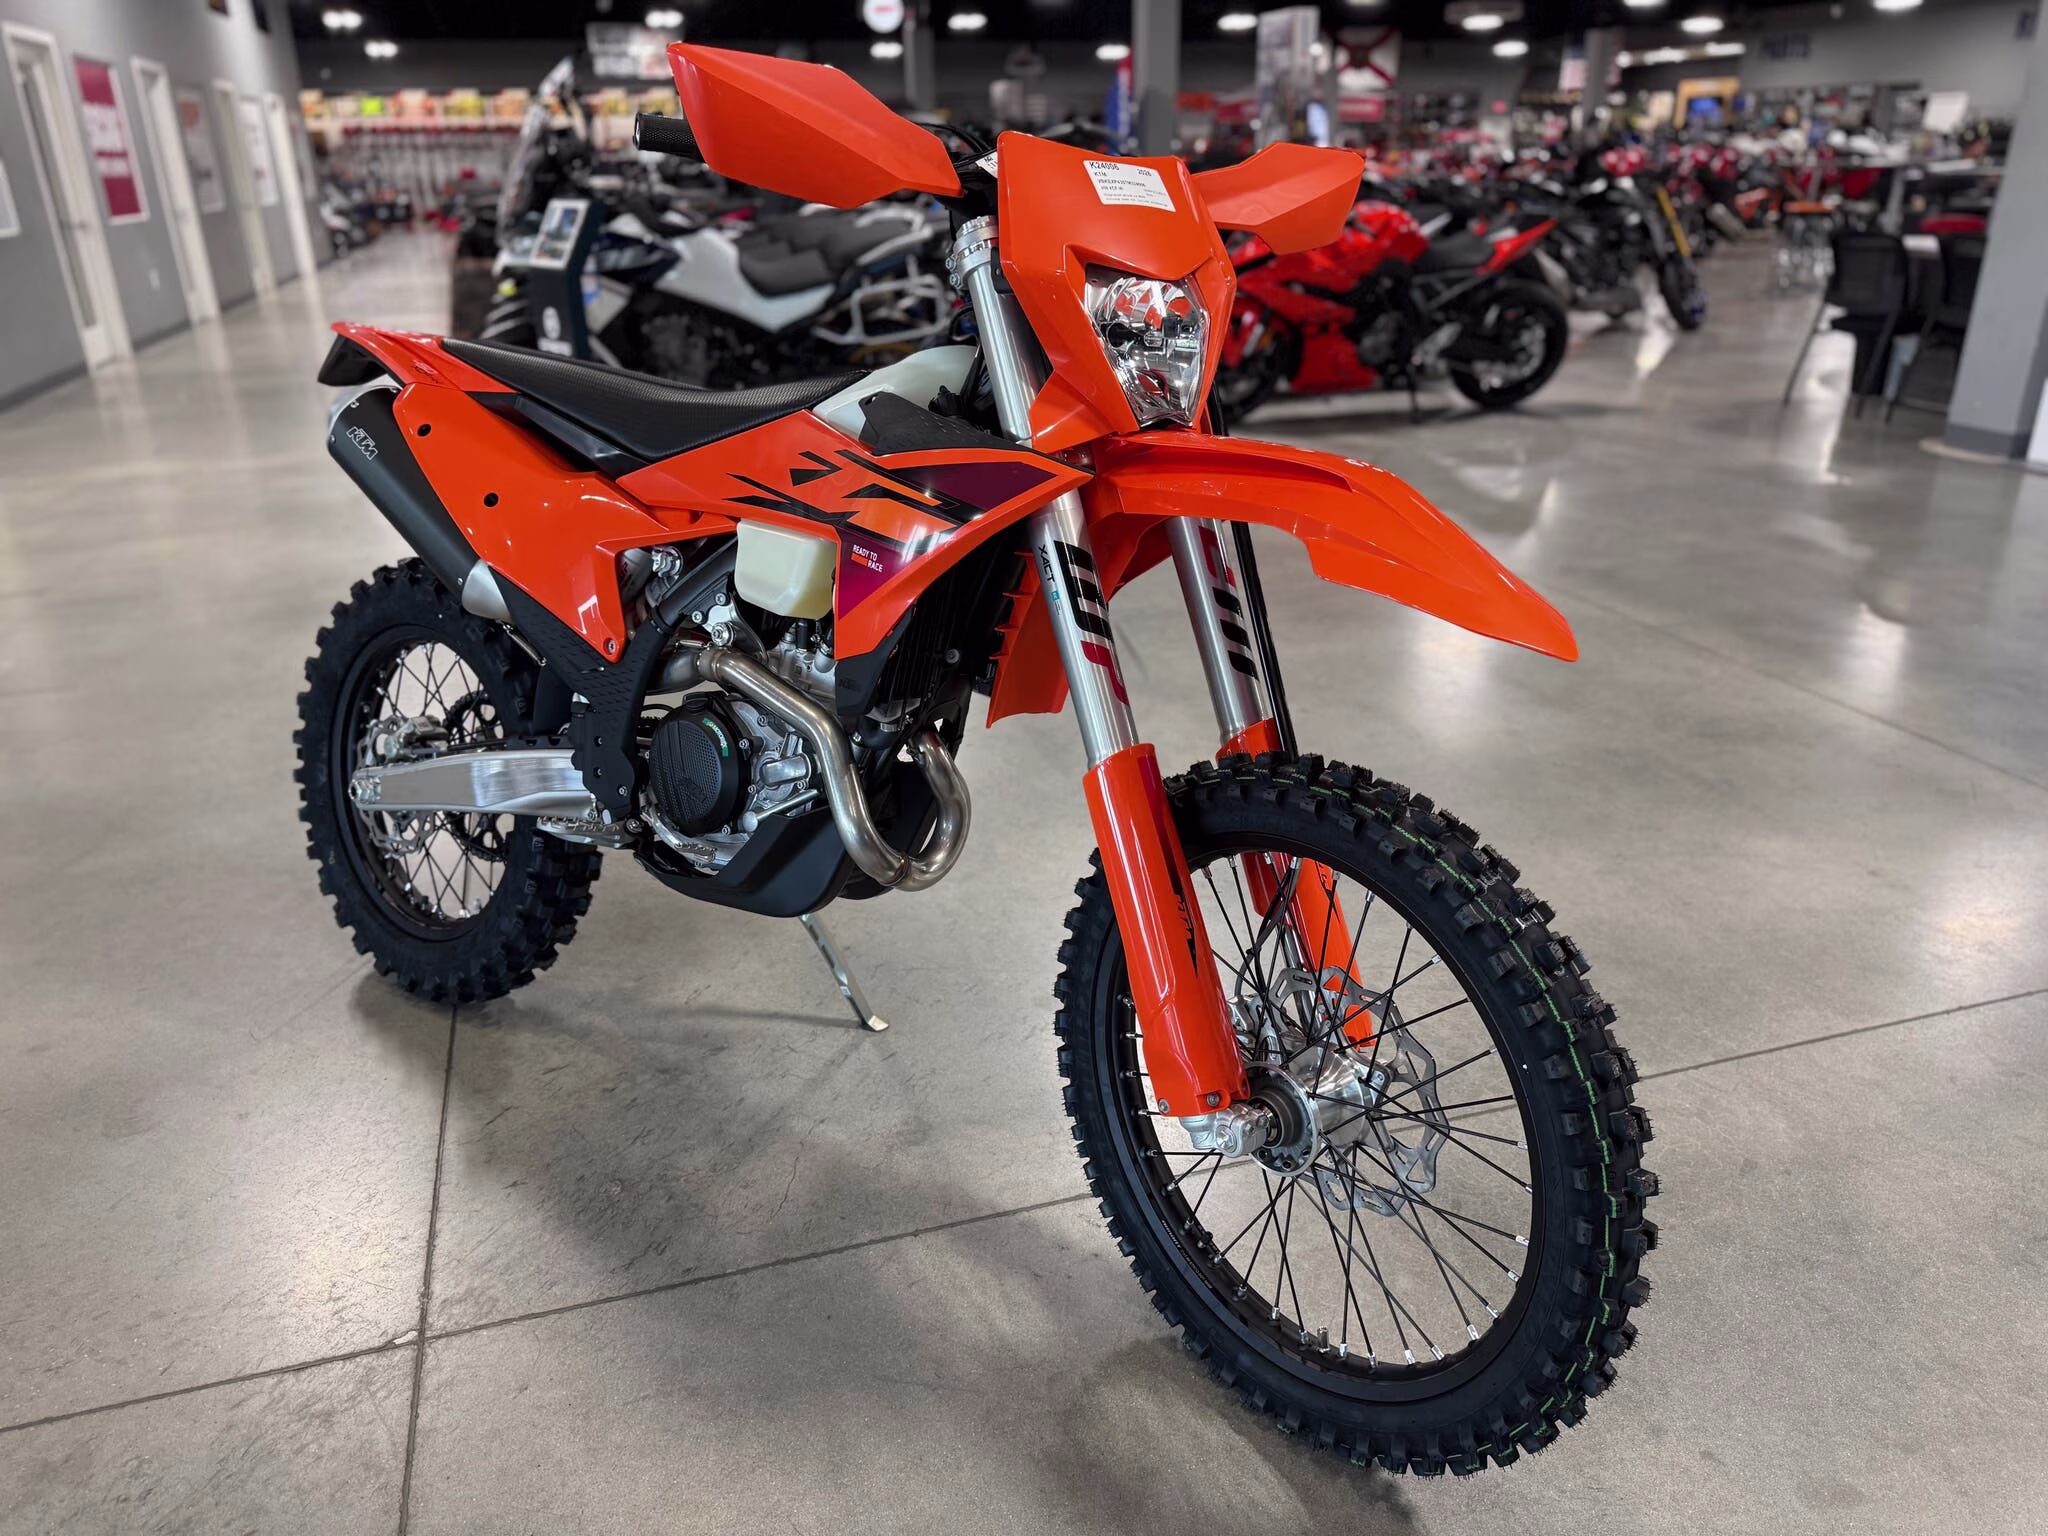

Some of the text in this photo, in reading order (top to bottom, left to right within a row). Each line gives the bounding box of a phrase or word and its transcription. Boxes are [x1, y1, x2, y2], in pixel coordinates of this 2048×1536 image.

[346, 426, 378, 460] KTM
[852, 544, 878, 561] READY TO
[1038, 544, 1056, 583] XACT
[867, 559, 883, 573] RACE
